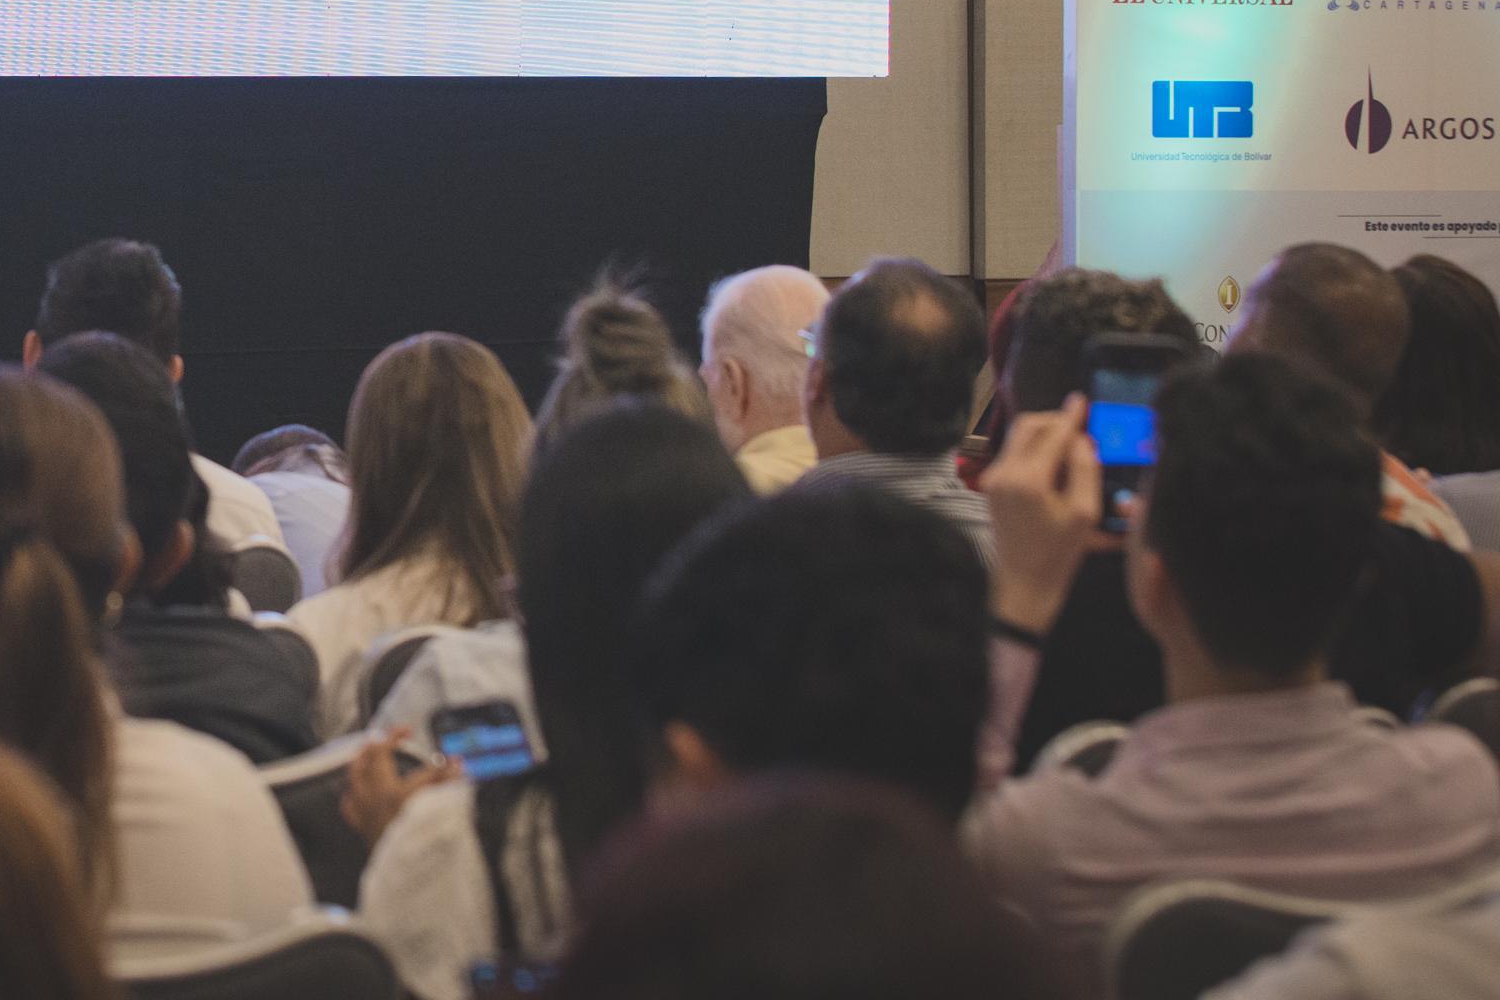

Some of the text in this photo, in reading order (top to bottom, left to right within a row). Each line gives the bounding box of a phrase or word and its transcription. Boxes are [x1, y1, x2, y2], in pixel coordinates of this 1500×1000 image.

[1363, 0, 1500, 11] CARTAGENA
[1402, 117, 1495, 140] ARGOS
[1131, 151, 1179, 161] Universidad
[1365, 221, 1497, 235] Este evento es apoyado
